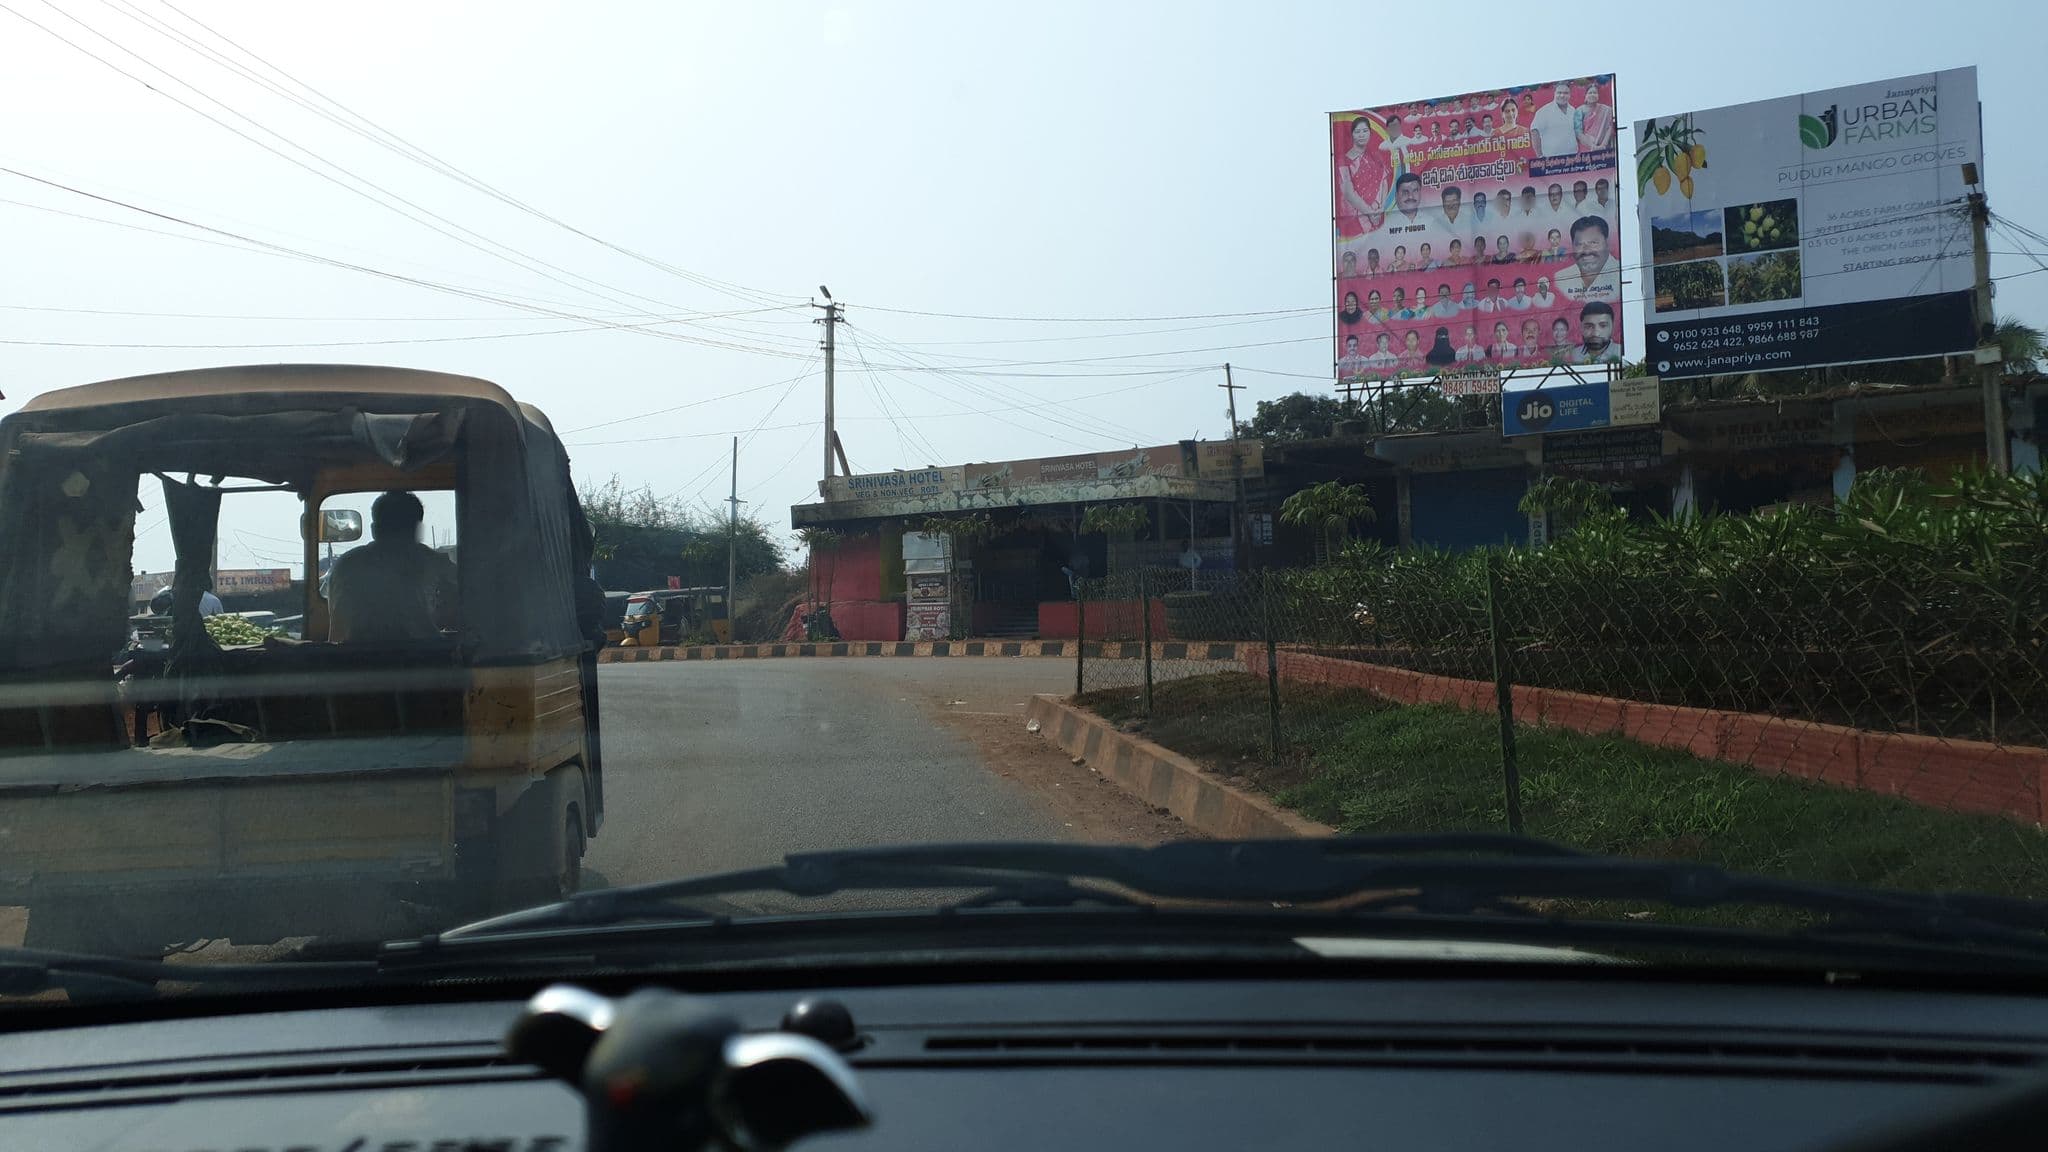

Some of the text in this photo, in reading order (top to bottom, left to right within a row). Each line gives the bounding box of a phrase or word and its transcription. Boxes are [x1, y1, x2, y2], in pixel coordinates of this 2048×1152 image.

[1885, 85, 1936, 99] Janapriya
[1844, 95, 1937, 125] URBAN
[1844, 115, 1936, 144] FARMS
[1778, 146, 1966, 184] PUDUR MANGO GROVES
[1840, 209, 1871, 220] ACRES
[1856, 231, 1887, 242] ACRES
[1899, 238, 1931, 250] GUEST
[1842, 259, 1896, 272] STARTING
[1898, 253, 1931, 266] FROM
[1673, 317, 1820, 340] 9100 933 648, 9959 111 843
[1673, 329, 1819, 352] 9652 624 422, 9866 688 987
[1674, 350, 1792, 369] www.janapriya.com
[1443, 379, 1498, 394] 98481 59455
[1521, 401, 1552, 420] Jio
[1560, 398, 1593, 408] DIGITAL
[1560, 408, 1579, 416] LIFE
[1040, 460, 1097, 474] SRINIVASA HOTEL
[848, 471, 945, 490] SRINIVASA HOTEL
[855, 490, 871, 498] VEG
[218, 577, 238, 586] TEL
